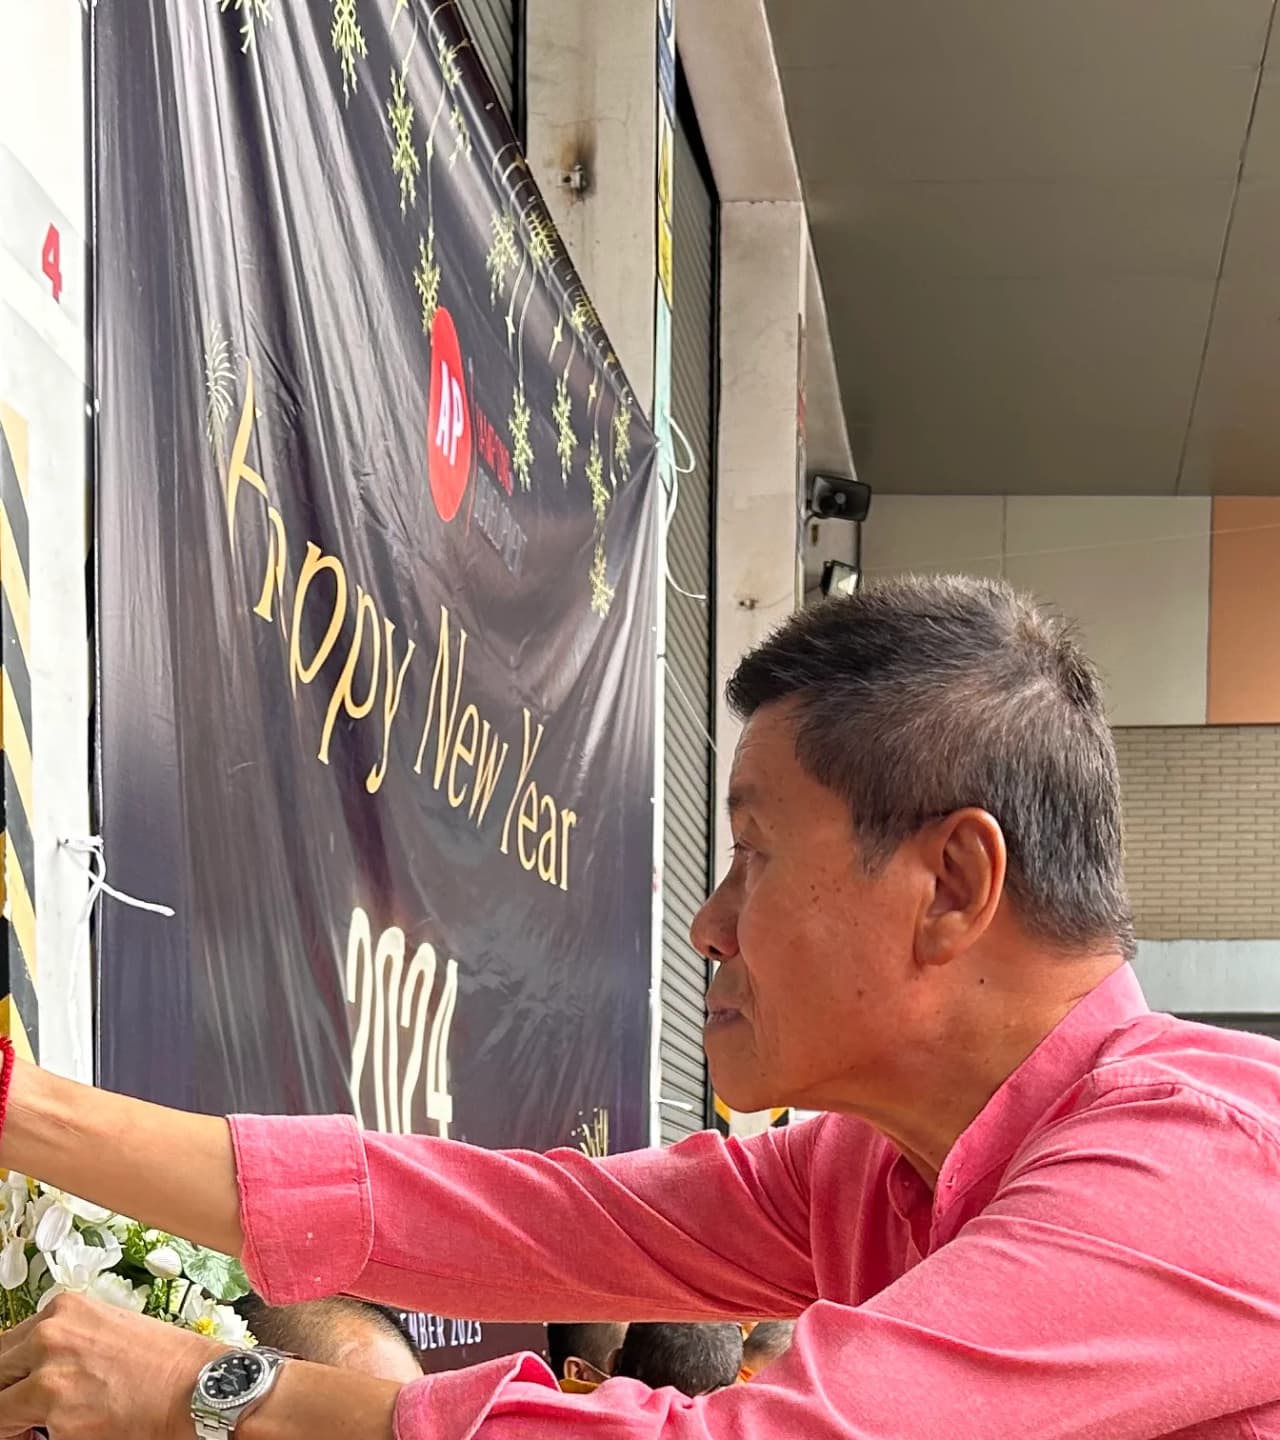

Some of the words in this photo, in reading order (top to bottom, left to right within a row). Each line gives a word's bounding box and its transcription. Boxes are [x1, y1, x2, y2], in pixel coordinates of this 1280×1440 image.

[42, 222, 62, 304] 4
[435, 360, 464, 466] AP
[414, 605, 509, 828] New
[500, 708, 577, 891] Year
[346, 906, 459, 1140] 2024
